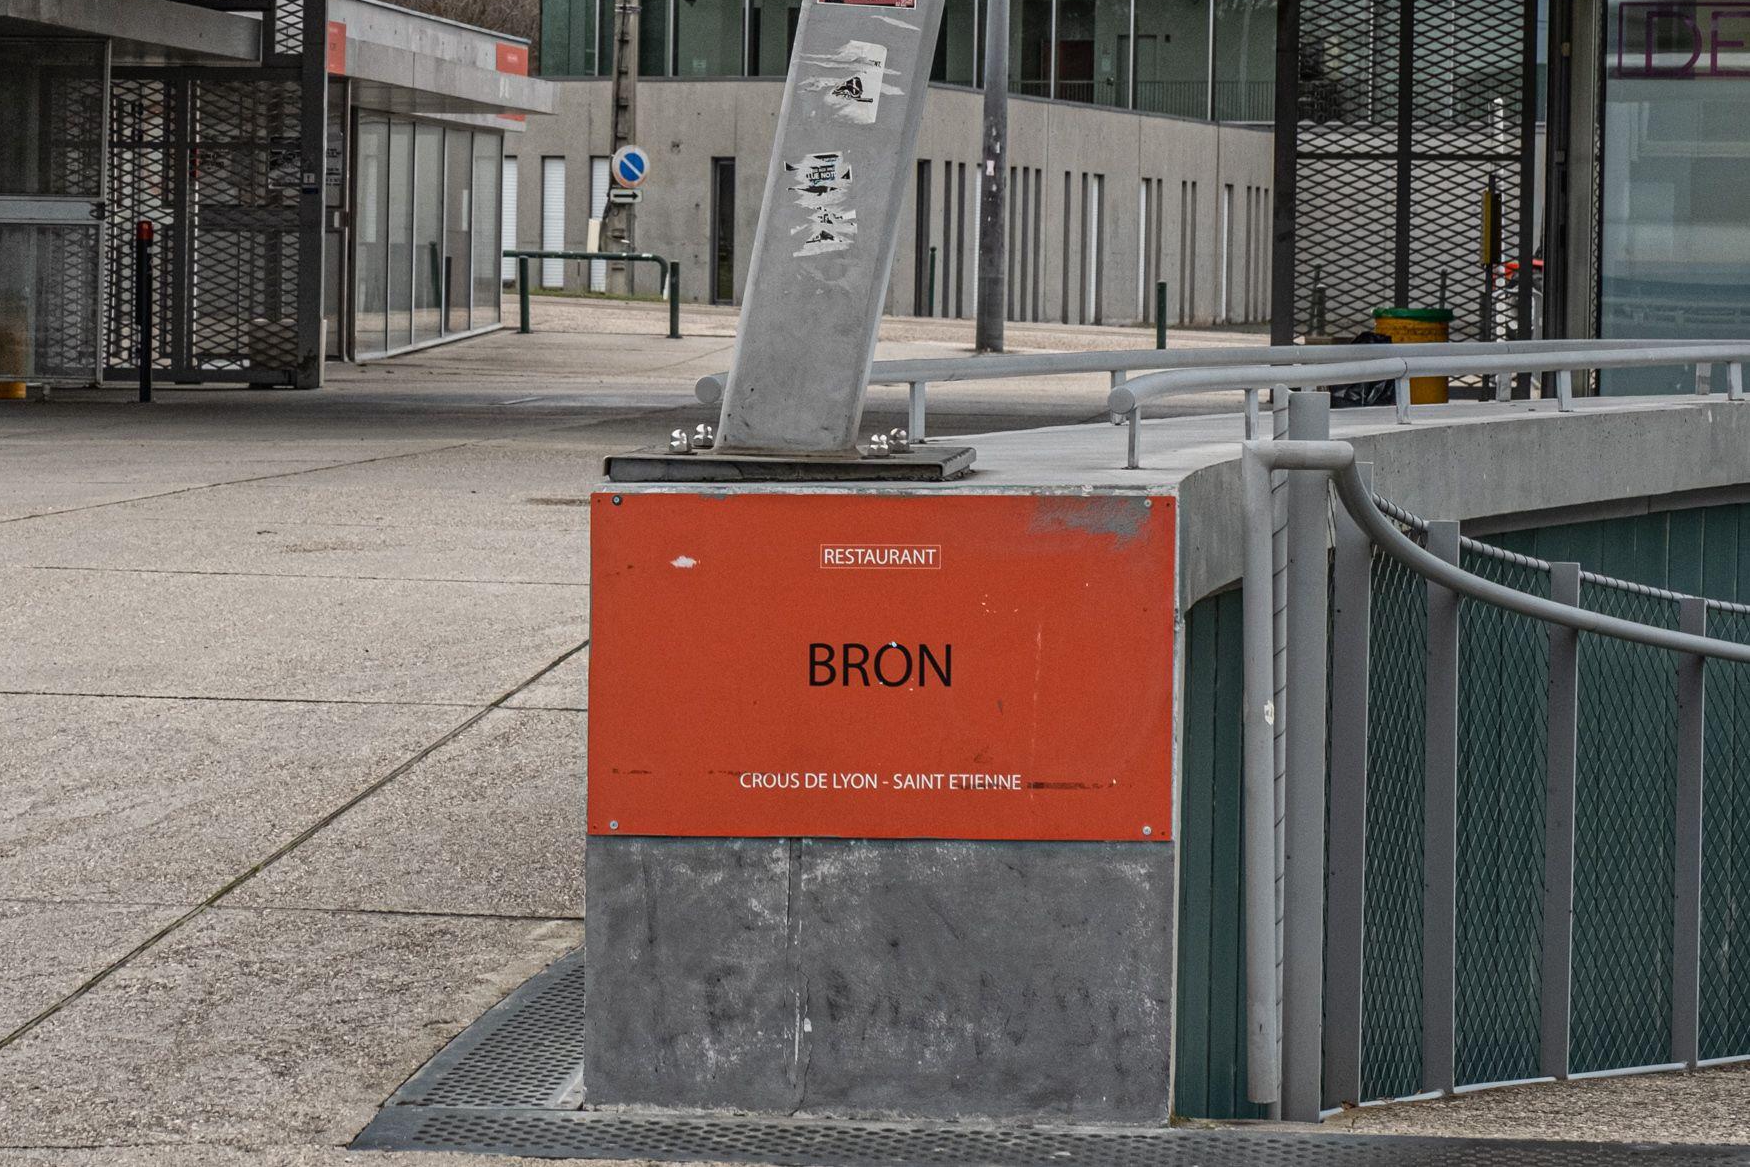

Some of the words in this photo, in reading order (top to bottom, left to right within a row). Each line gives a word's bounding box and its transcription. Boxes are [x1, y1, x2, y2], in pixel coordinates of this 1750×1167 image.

[824, 548, 937, 565] RESTAURANT
[809, 642, 952, 687] BRON
[739, 772, 800, 789] CROUS
[805, 773, 827, 789] DE
[833, 773, 878, 789] LYON
[893, 773, 945, 790] SAINT
[949, 774, 1022, 791] ETIENNE
